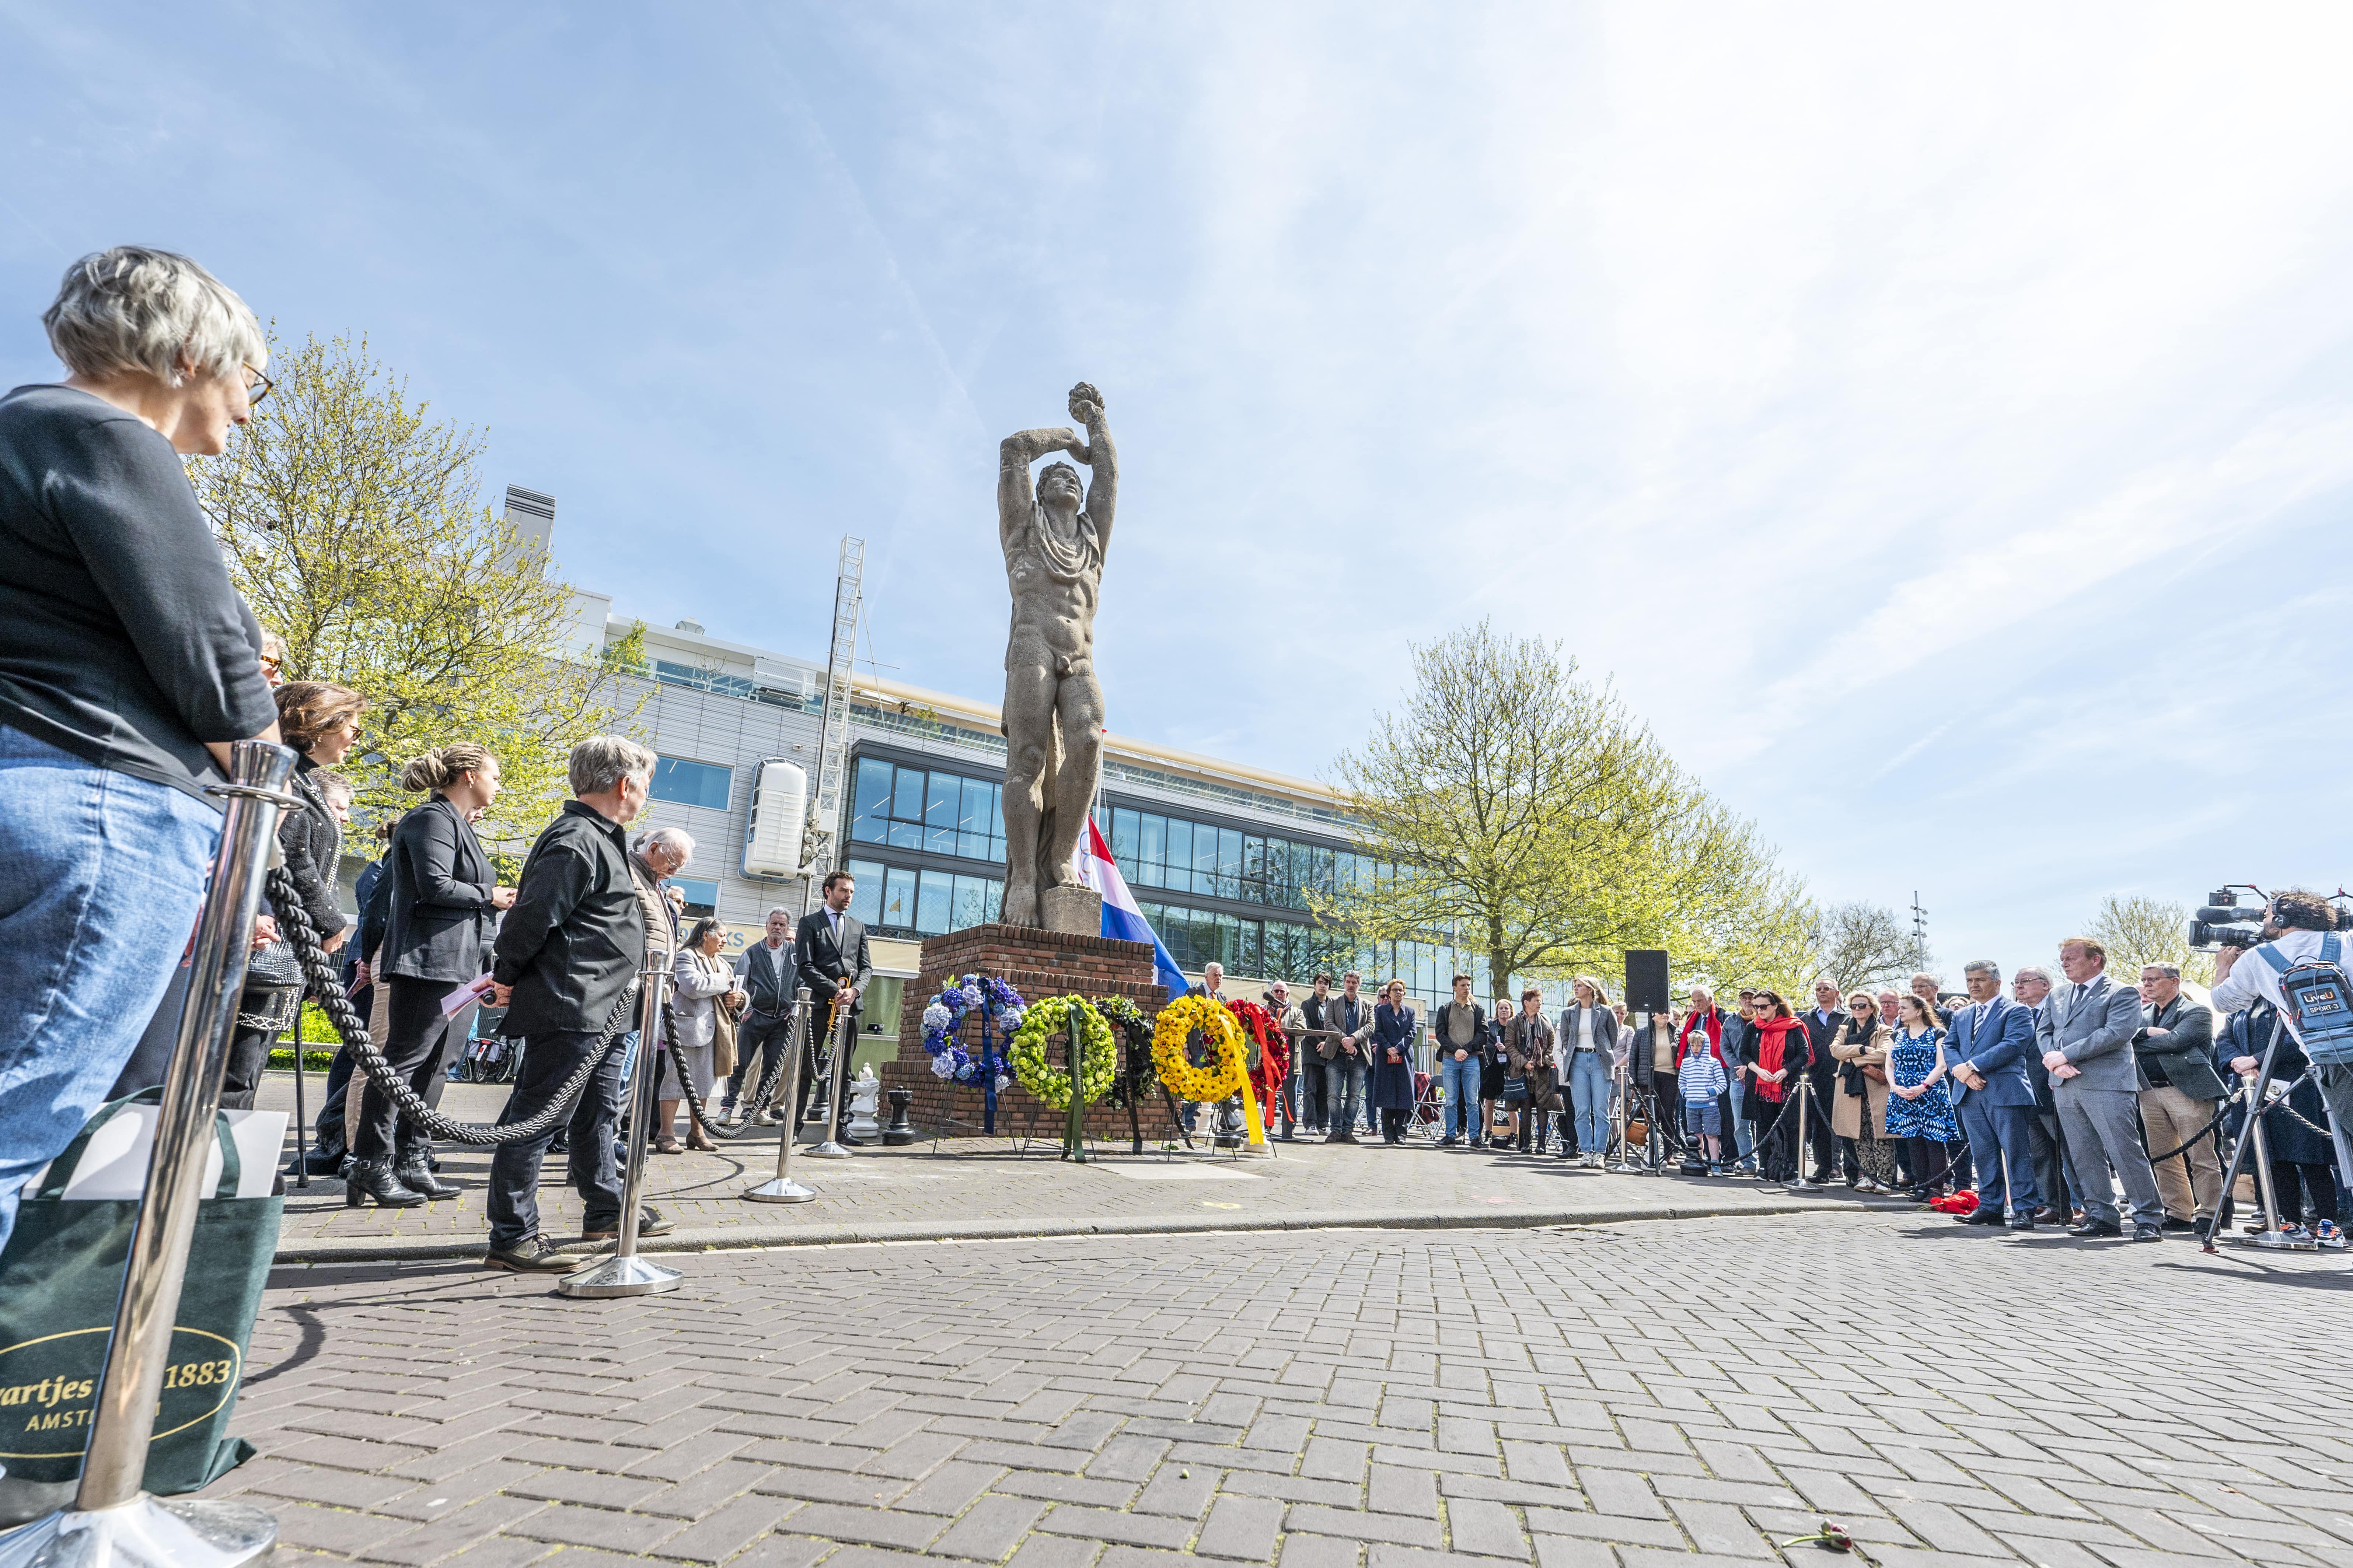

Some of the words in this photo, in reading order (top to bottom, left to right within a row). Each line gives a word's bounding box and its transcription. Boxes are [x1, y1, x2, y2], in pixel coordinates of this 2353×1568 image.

[2309, 1004, 2339, 1013] SPORT-3
[0, 1375, 94, 1408] artjes
[164, 1359, 231, 1389] 1883
